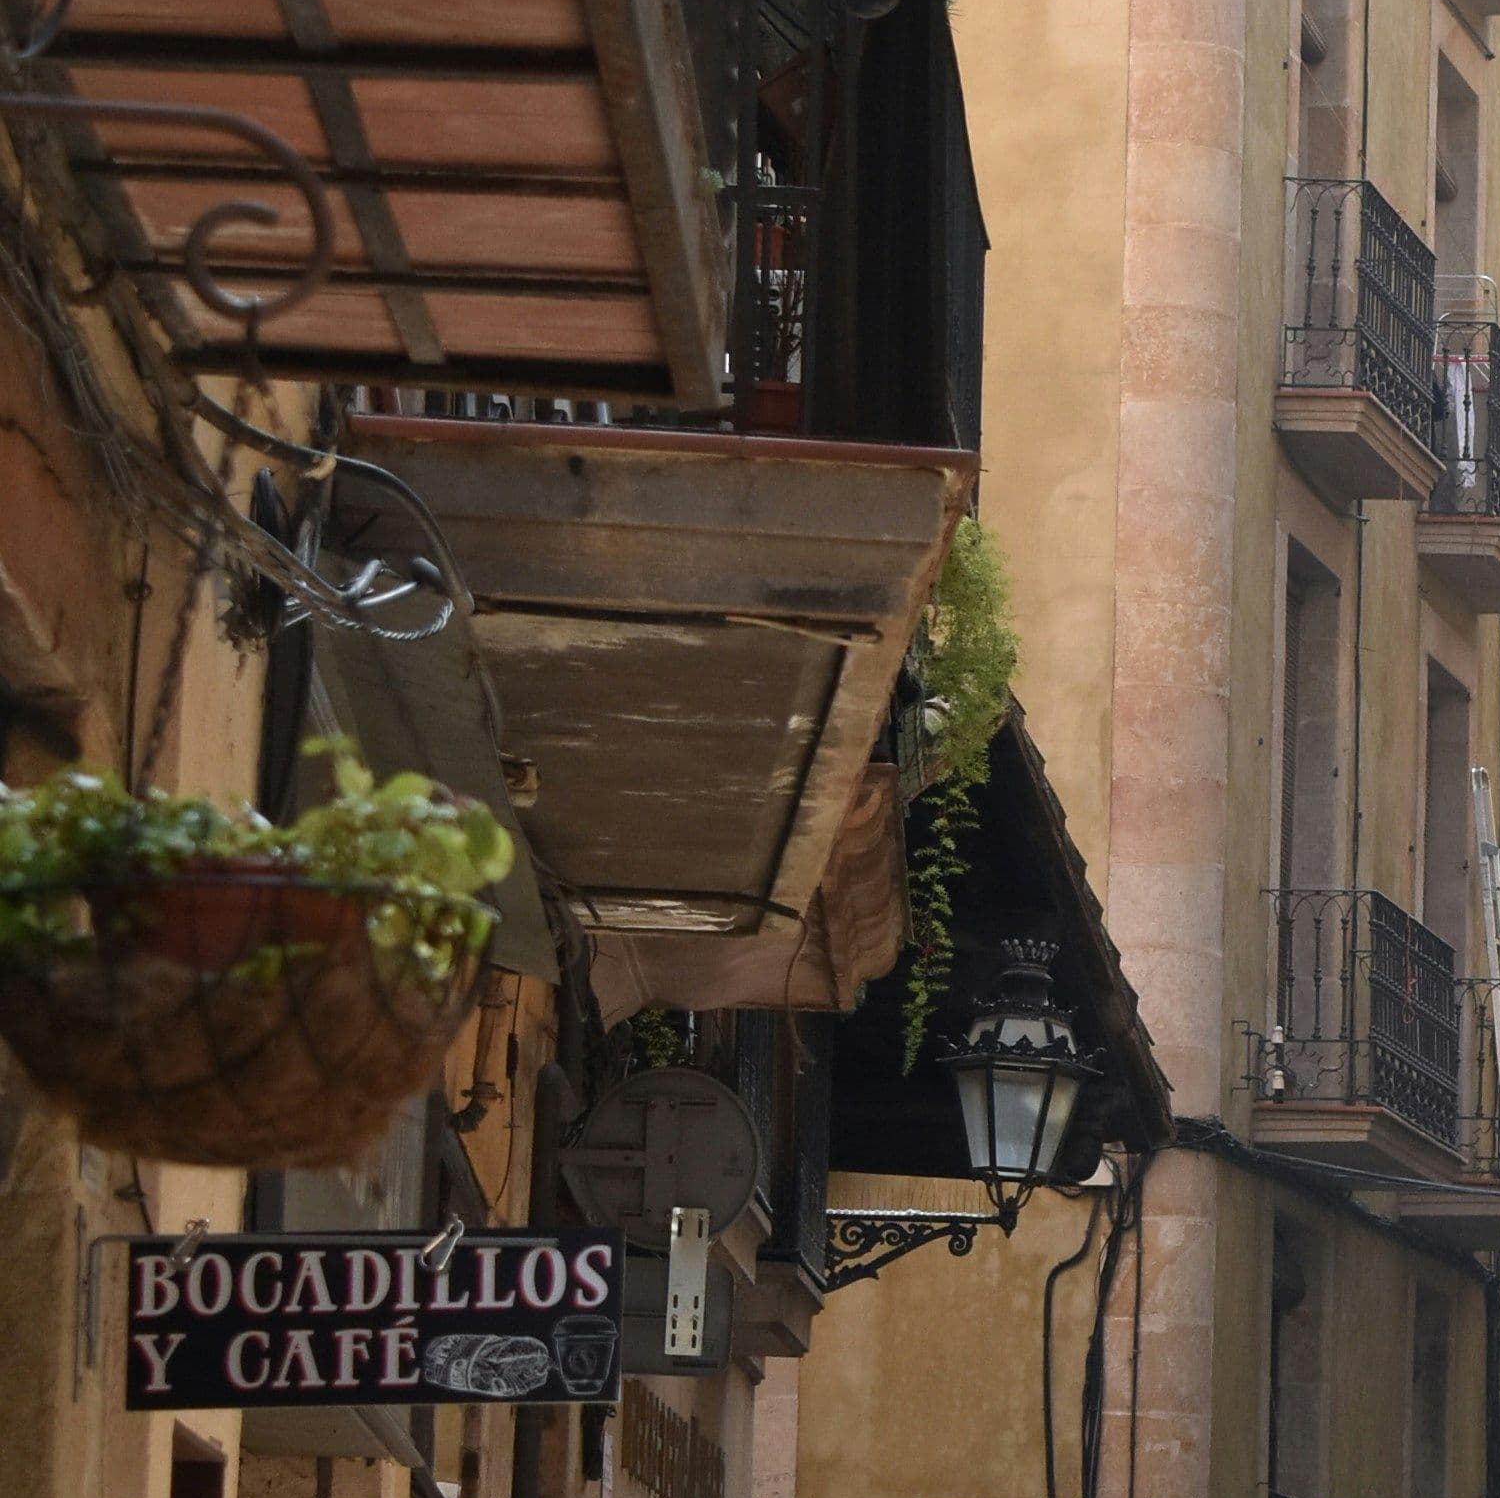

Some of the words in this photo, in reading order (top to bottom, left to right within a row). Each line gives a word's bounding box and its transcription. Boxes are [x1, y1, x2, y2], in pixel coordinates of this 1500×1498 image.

[135, 1245, 613, 1317] BOCADILLOS
[134, 1332, 187, 1392] Y
[226, 1318, 422, 1390] CAFÉ
